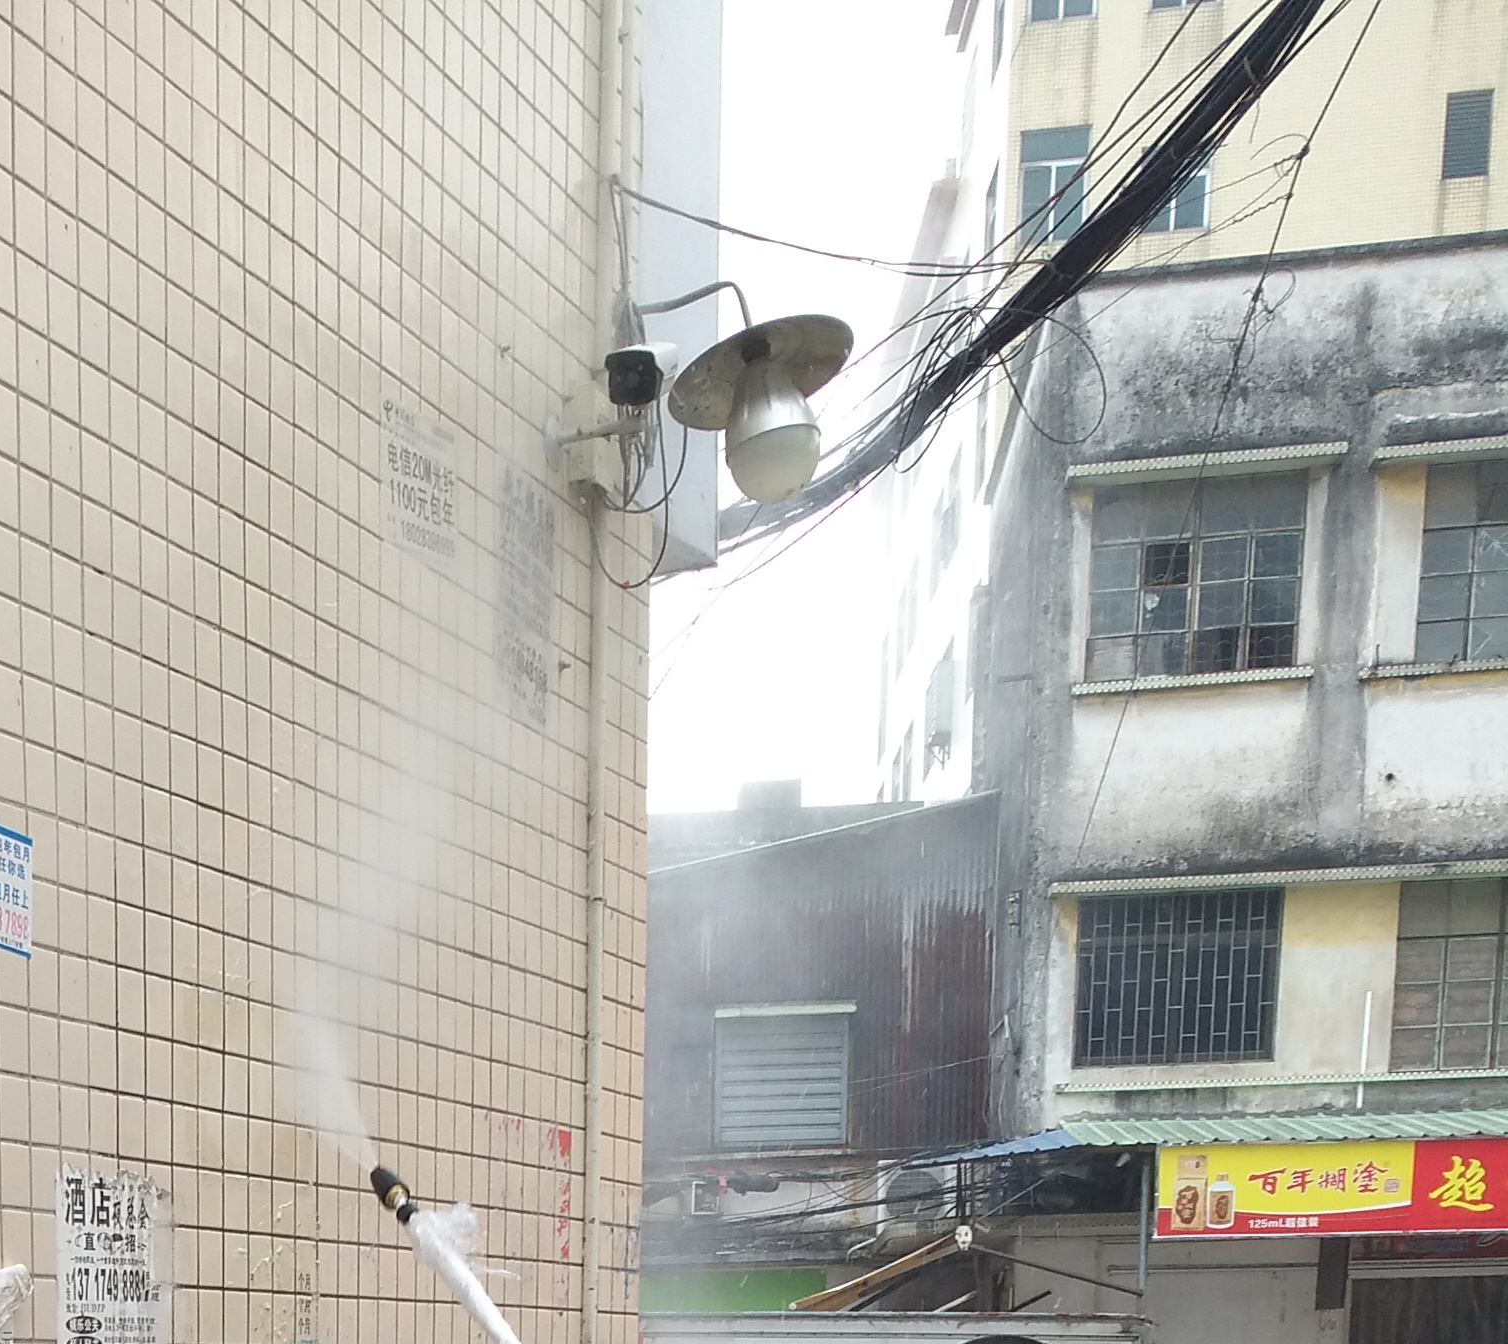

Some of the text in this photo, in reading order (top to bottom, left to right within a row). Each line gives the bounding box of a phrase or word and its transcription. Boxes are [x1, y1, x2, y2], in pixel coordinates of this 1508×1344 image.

[1247, 1160, 1388, 1196] 百年糊塗
[1429, 1155, 1494, 1212] 超
[71, 1267, 90, 1302] 137
[94, 1268, 119, 1302] 1749
